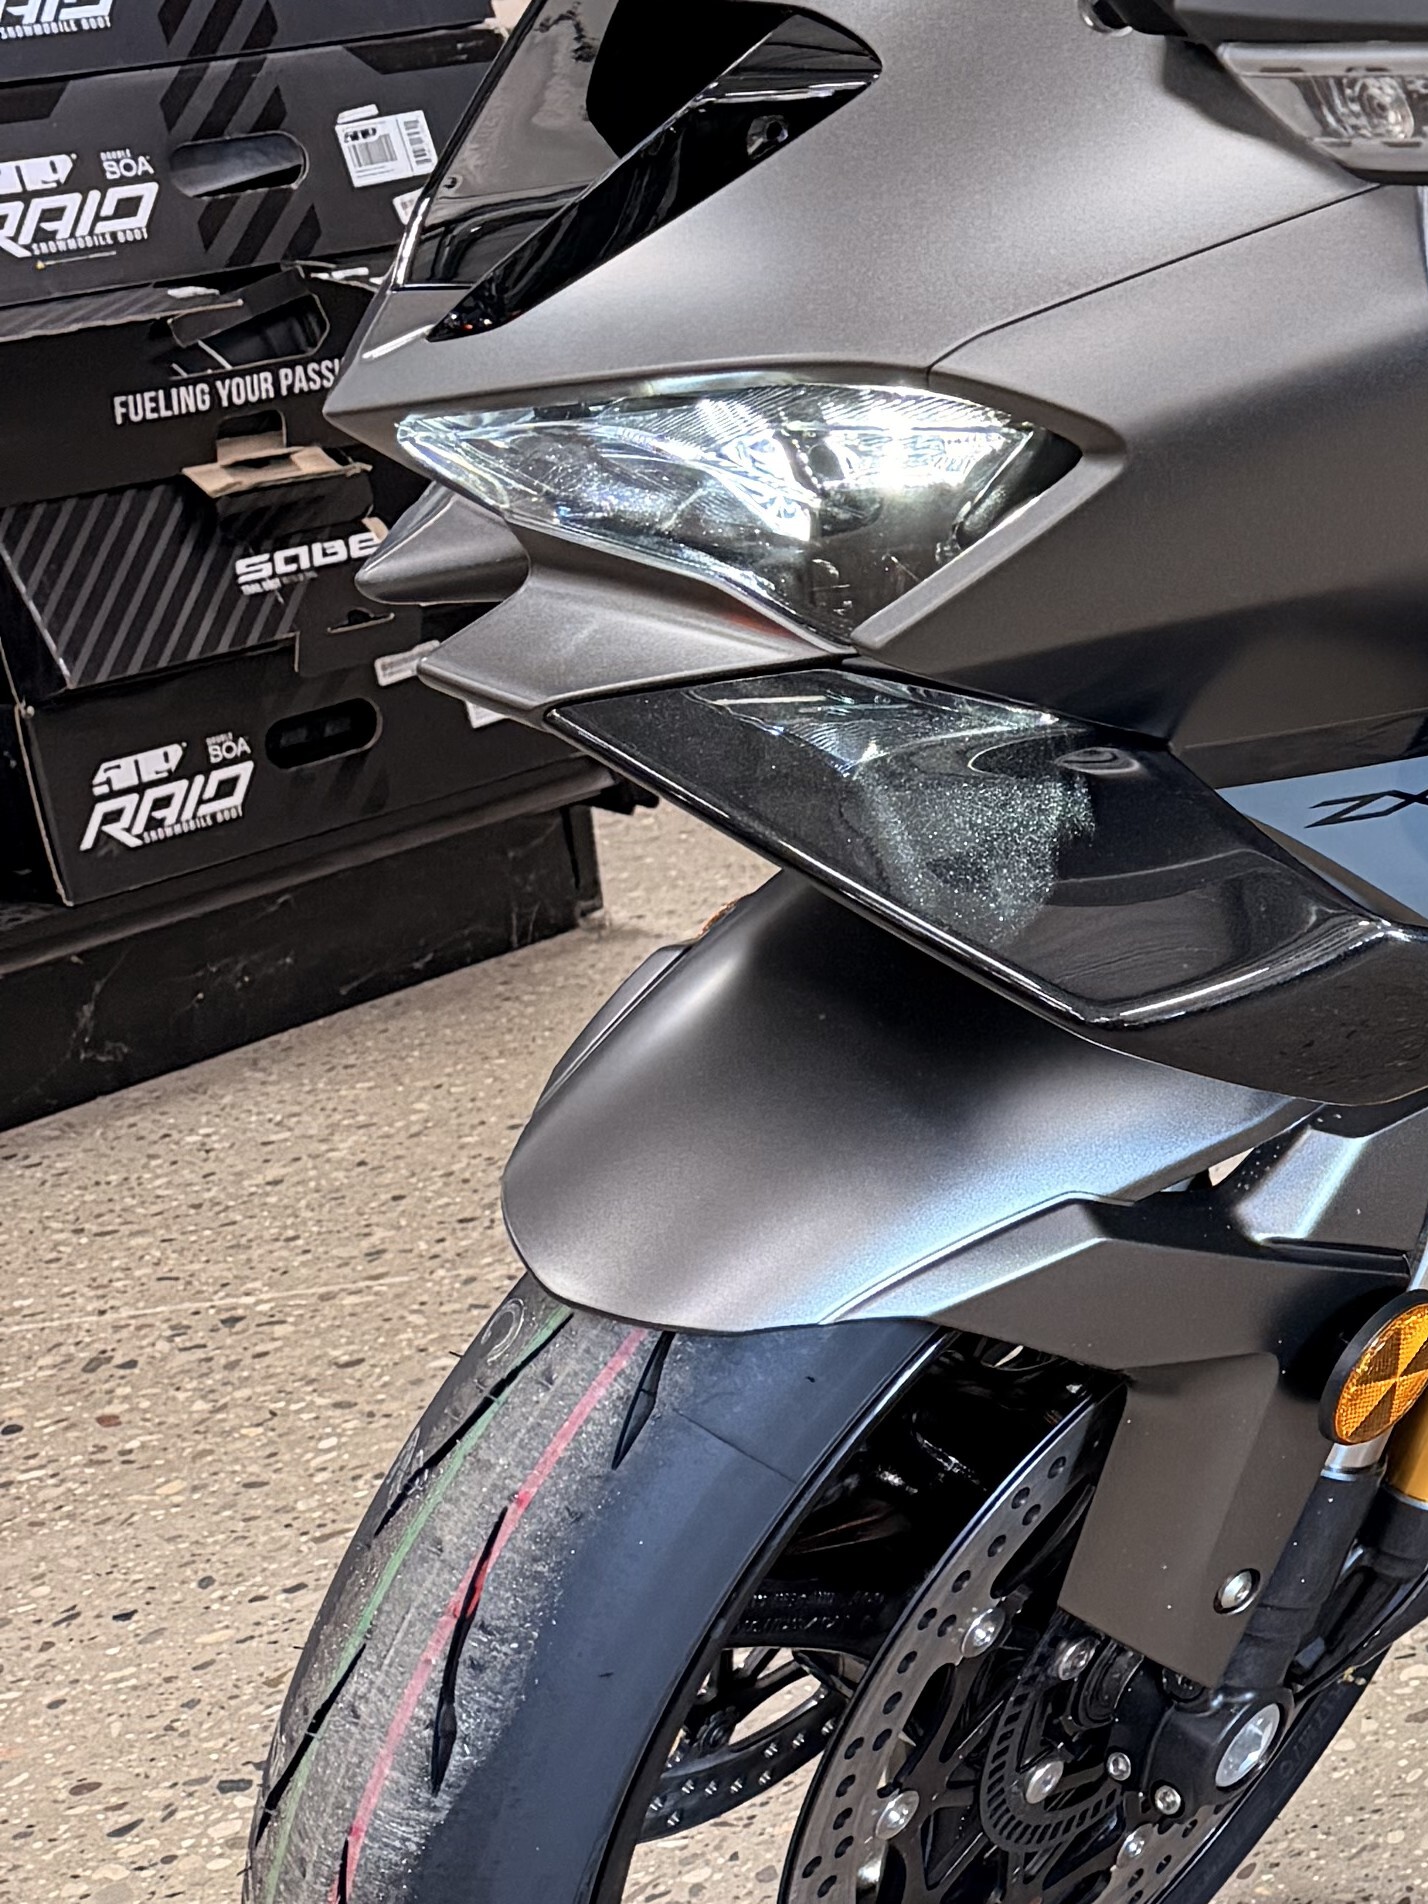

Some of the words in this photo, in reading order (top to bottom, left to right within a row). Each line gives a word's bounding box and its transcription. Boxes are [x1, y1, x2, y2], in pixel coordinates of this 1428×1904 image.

[102, 155, 155, 180] BOA
[113, 383, 211, 426] FUELING
[215, 369, 275, 408] YOUR
[208, 736, 252, 764] BOA
[79, 759, 255, 852] RAID
